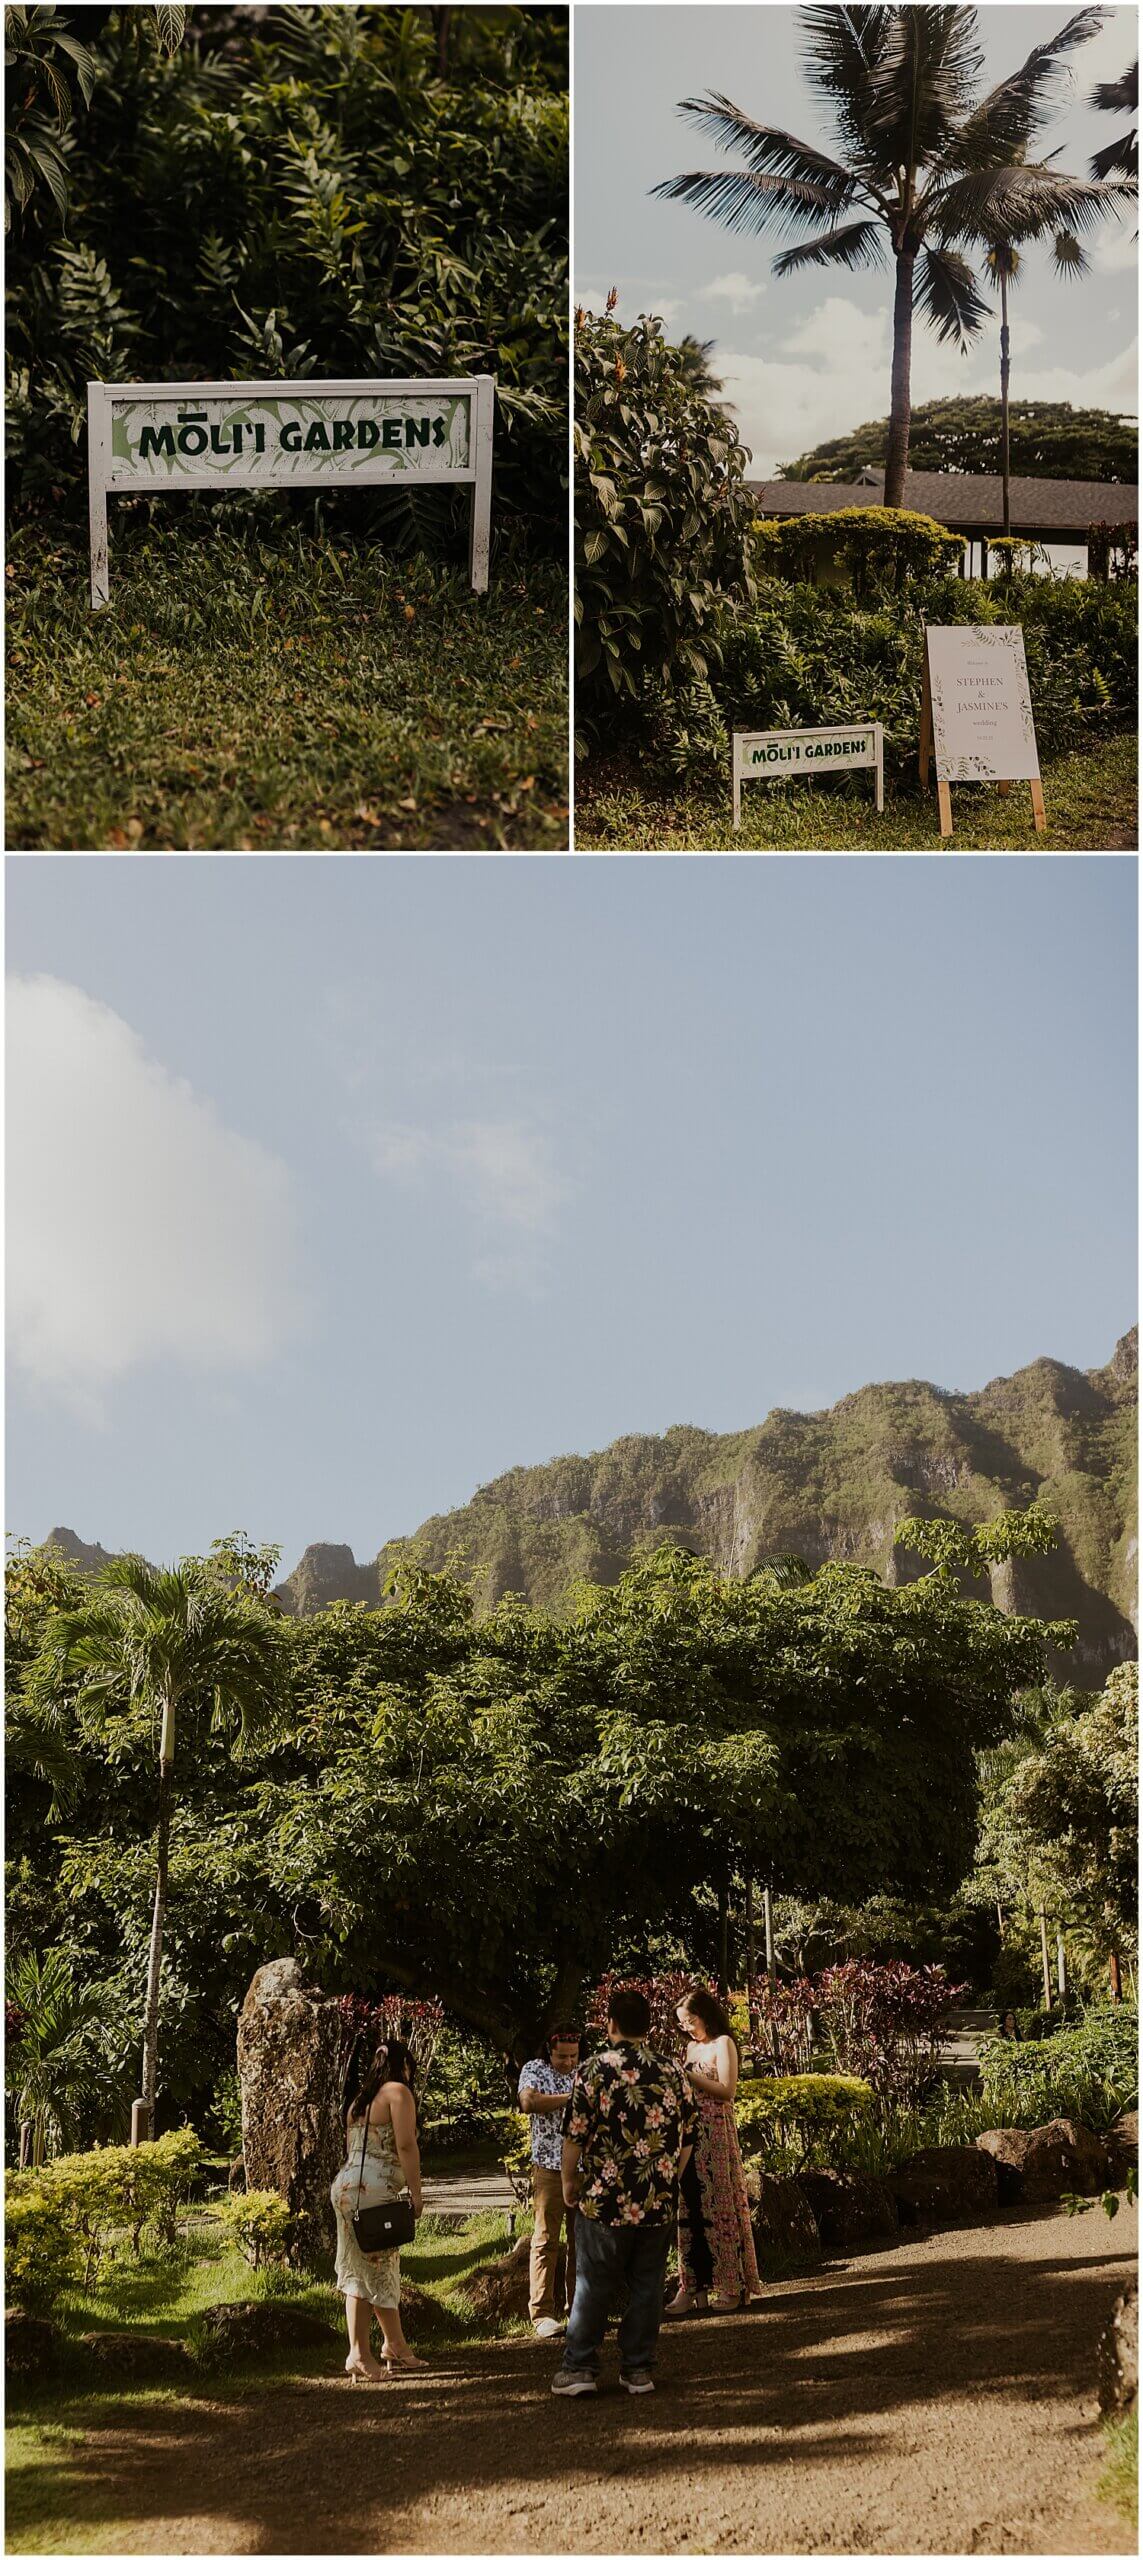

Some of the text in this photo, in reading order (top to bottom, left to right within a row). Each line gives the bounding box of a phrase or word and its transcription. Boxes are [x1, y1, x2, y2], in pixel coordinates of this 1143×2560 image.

[280, 416, 446, 453] GARDENS
[956, 677, 1004, 686] STEPHEN
[977, 690, 985, 698] &
[956, 701, 1009, 713] JASMINE'S
[805, 740, 866, 758] GARDENS
